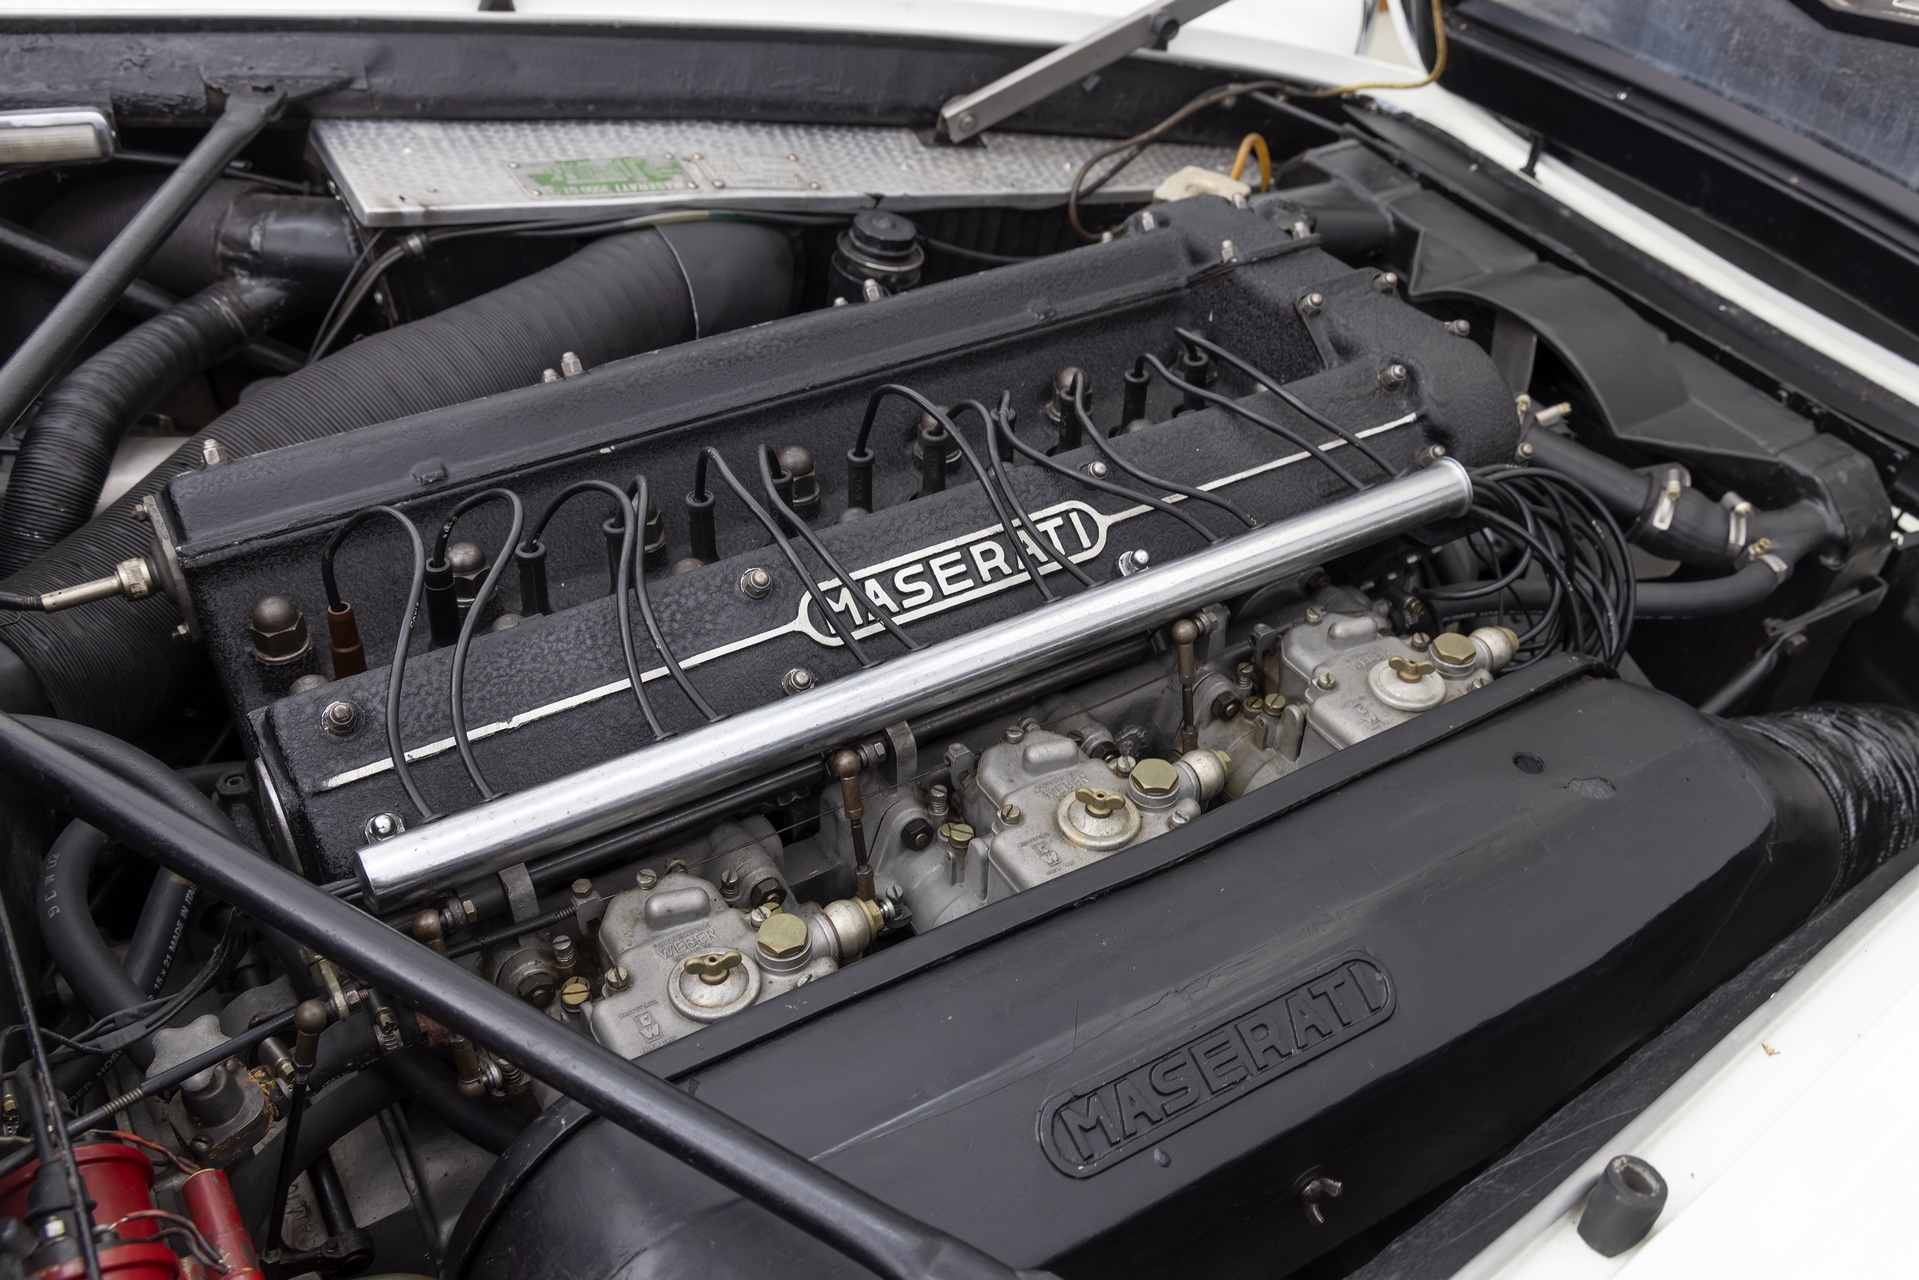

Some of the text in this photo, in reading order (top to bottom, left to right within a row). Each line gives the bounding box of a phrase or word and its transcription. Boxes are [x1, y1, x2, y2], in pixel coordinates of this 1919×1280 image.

[820, 511, 1092, 634] MASERATI
[154, 976, 163, 989] 15
[163, 954, 173, 968] 21
[168, 919, 184, 952] MADE
[180, 905, 190, 919] IN
[656, 928, 718, 960] WEBER
[1059, 963, 1382, 1161] MASERATI
